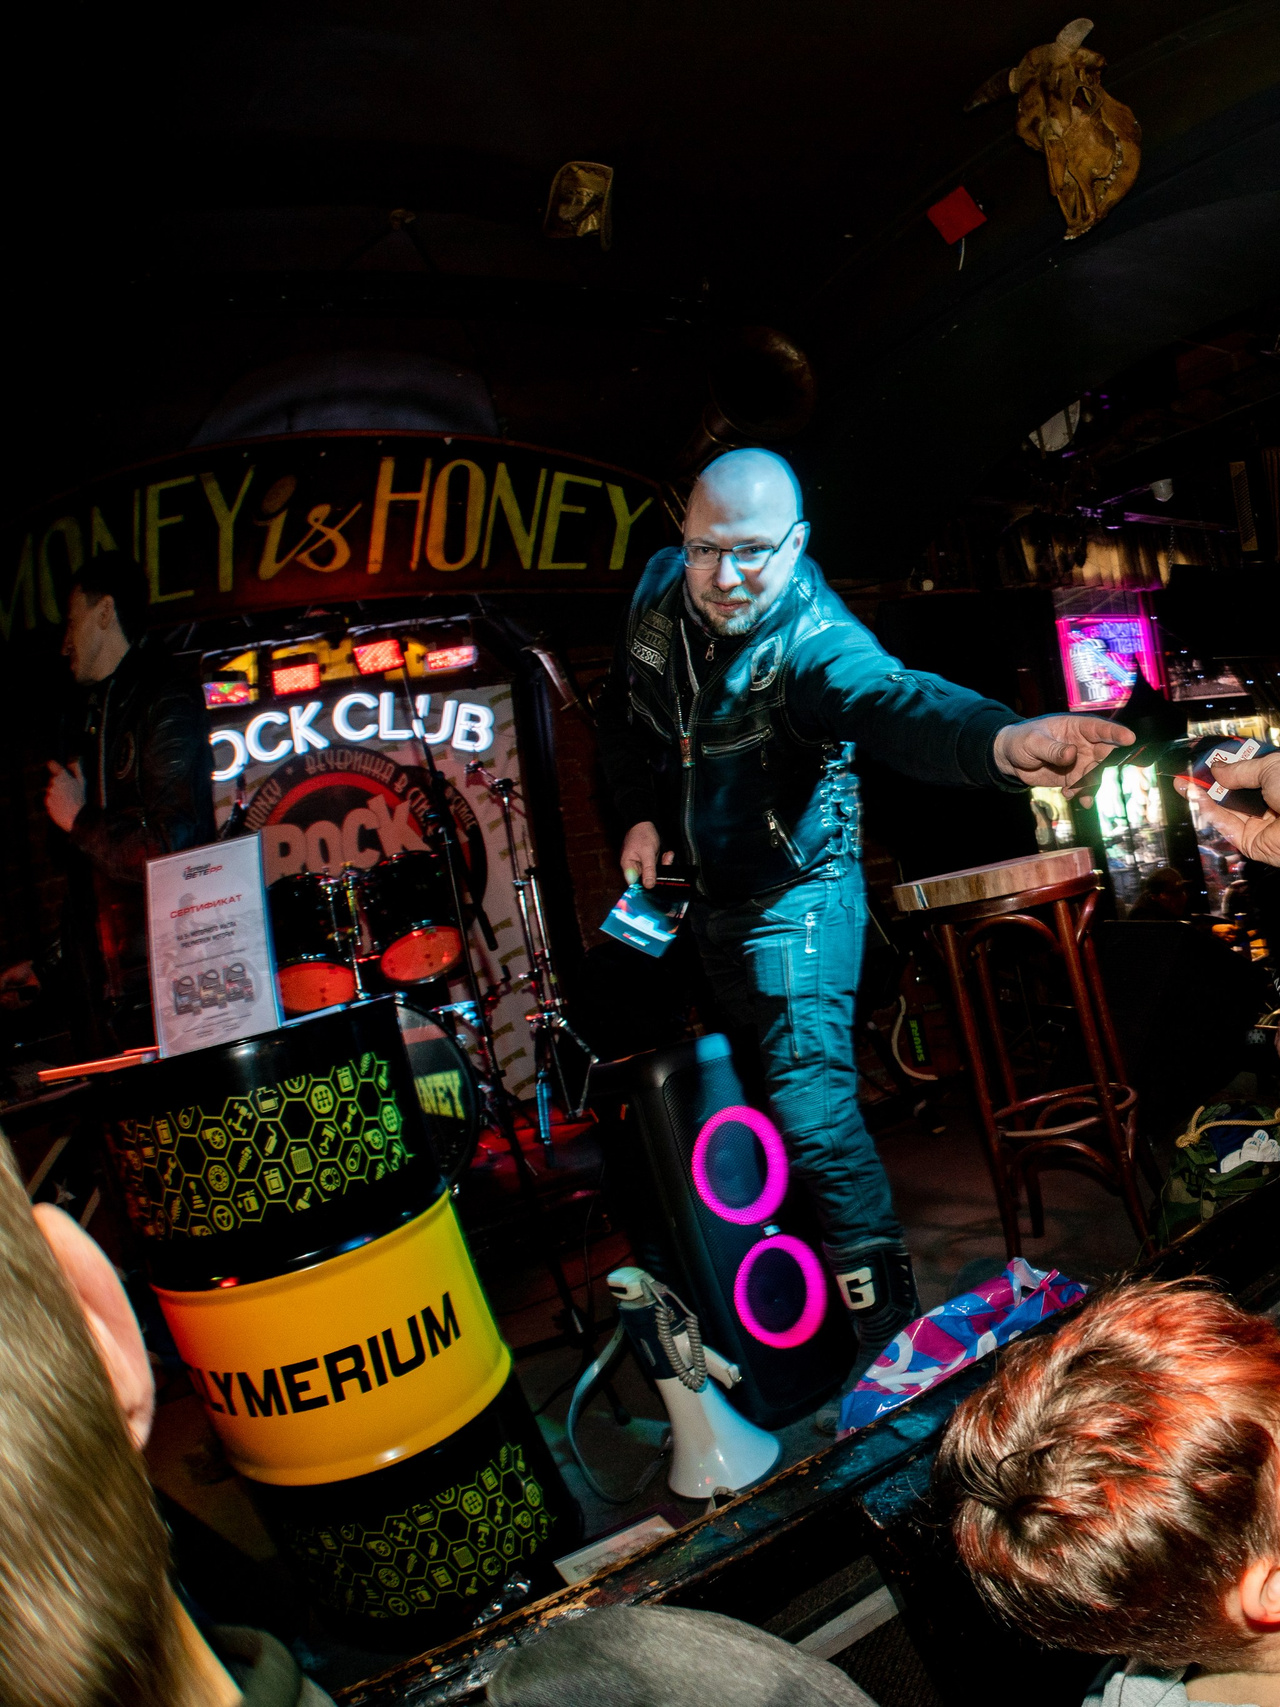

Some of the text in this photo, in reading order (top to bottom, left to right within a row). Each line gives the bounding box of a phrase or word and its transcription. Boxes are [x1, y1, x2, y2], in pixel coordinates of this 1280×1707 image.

[250, 473, 362, 581] is
[366, 456, 655, 574] HONEY
[208, 692, 494, 781] OCK CLUB
[260, 793, 432, 885] ROCK
[170, 894, 242, 919] СЕРТИФИКАТ
[836, 1266, 876, 1310] G
[198, 1291, 461, 1418] LYMERIUM
